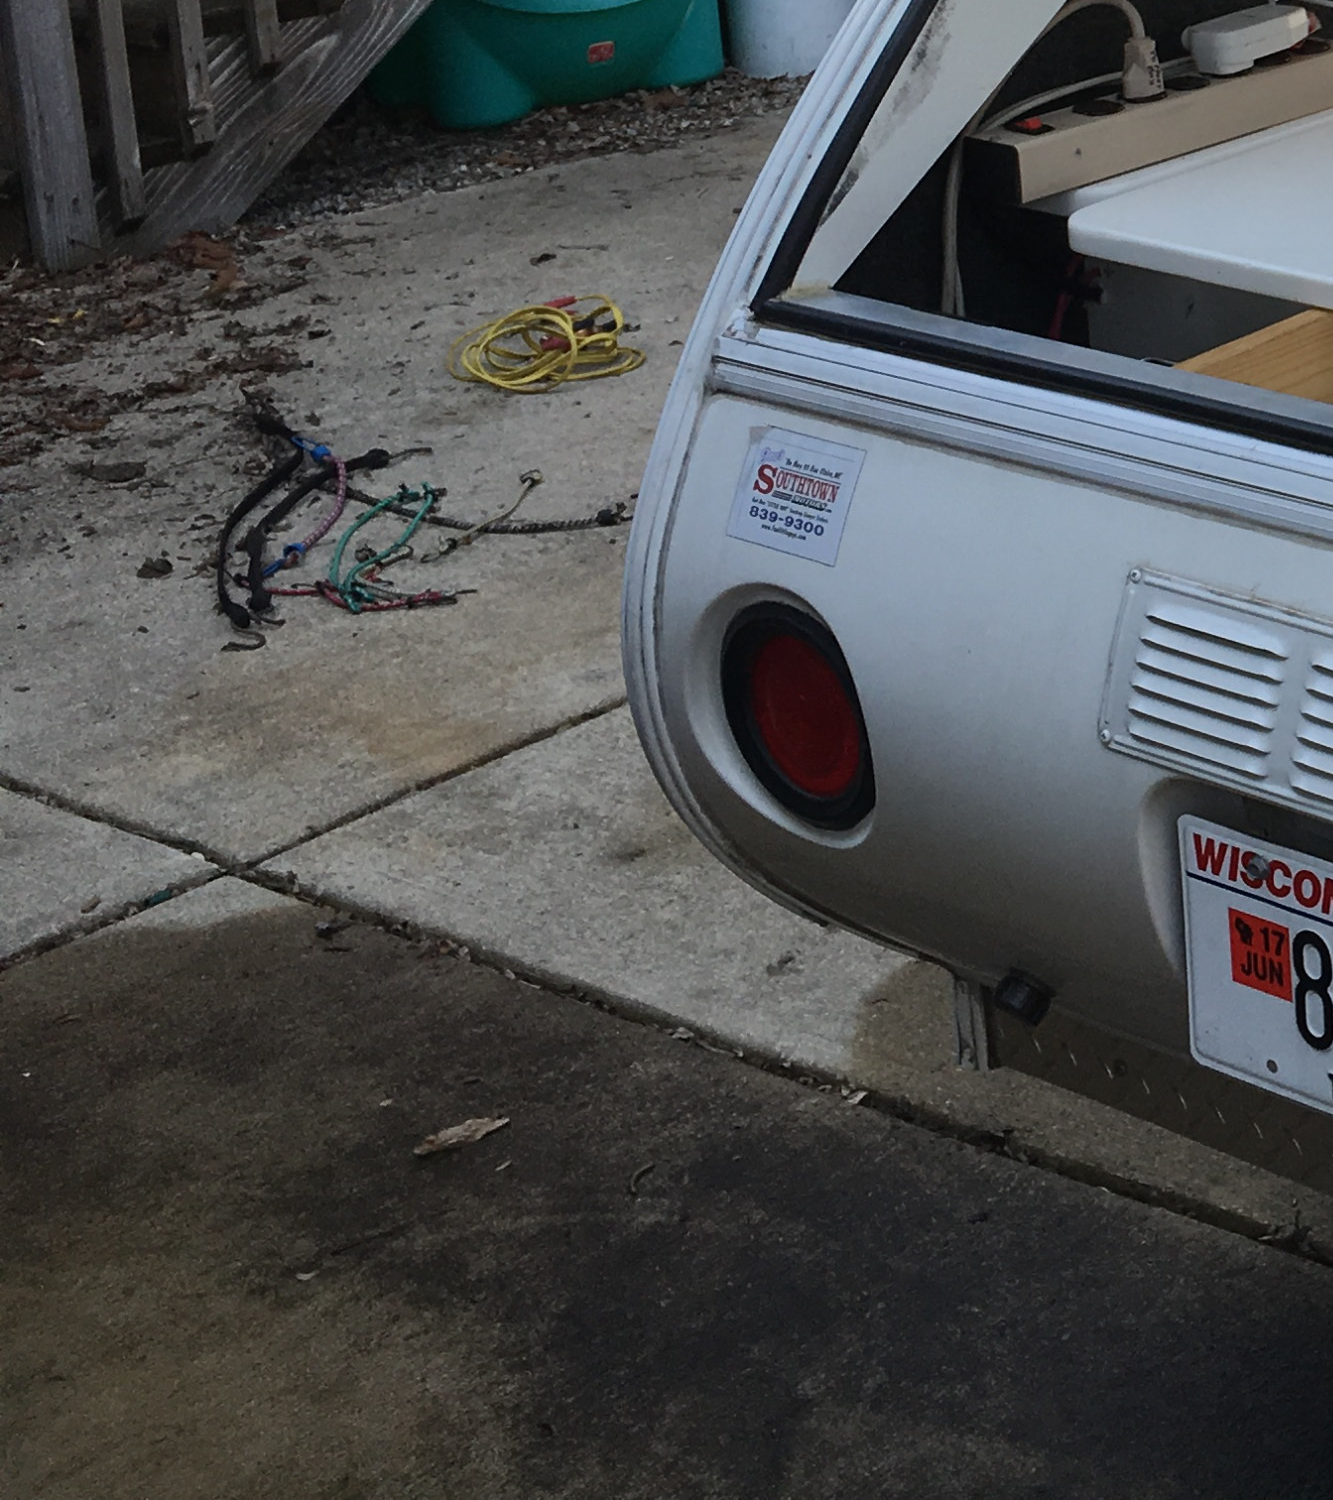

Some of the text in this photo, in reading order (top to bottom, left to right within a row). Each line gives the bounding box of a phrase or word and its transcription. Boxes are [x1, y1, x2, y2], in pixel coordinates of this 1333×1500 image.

[753, 463, 841, 504] SOUTHTOWN
[749, 505, 825, 536] 839-9300
[1260, 926, 1288, 956] 17
[1240, 951, 1285, 988] JUN
